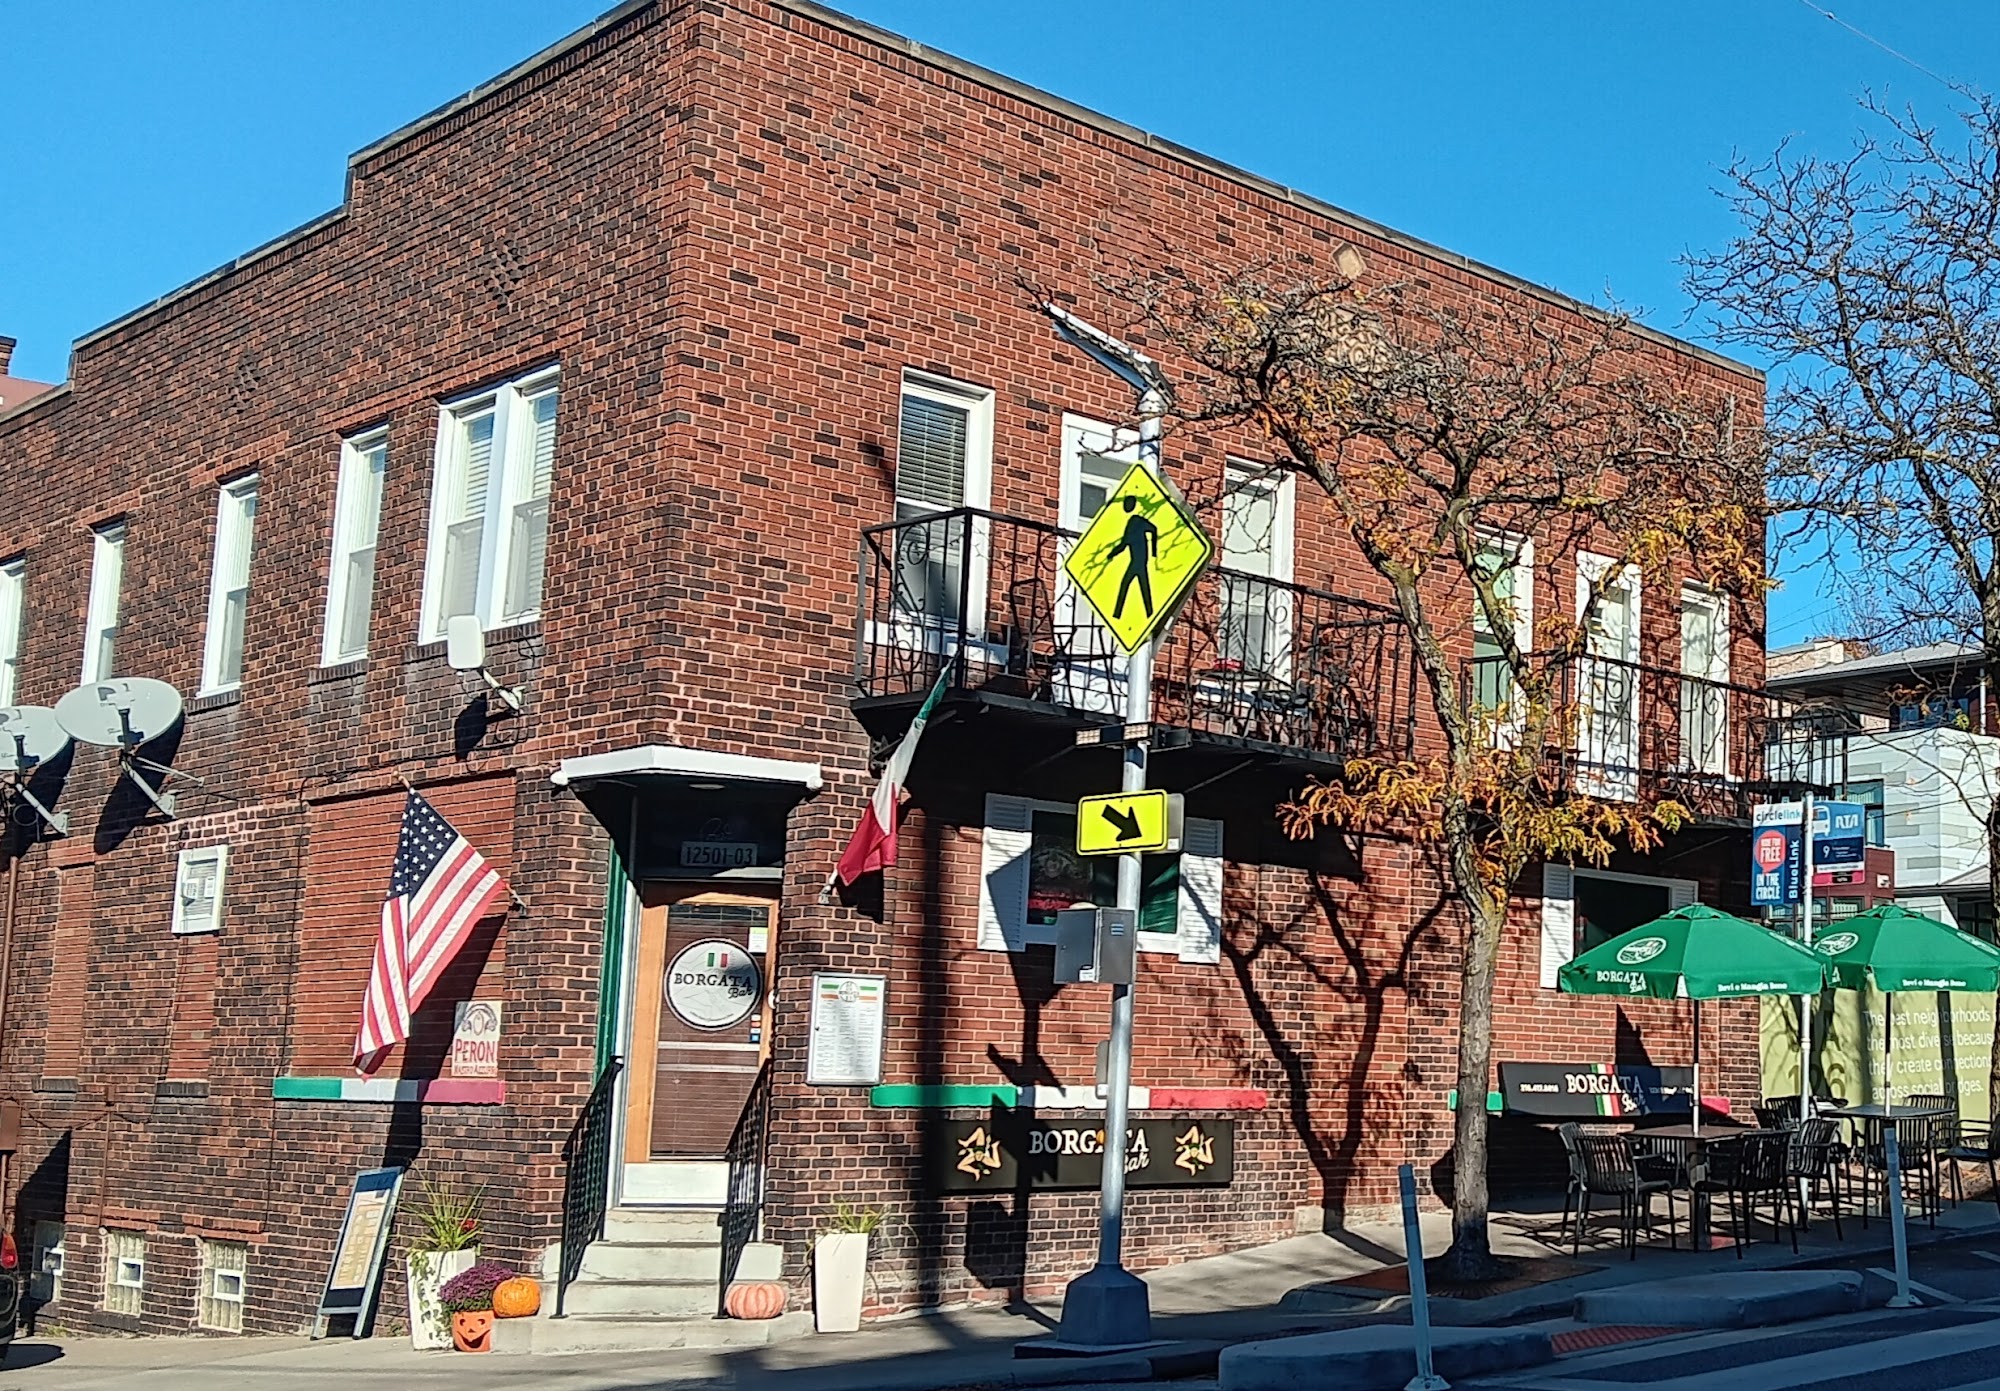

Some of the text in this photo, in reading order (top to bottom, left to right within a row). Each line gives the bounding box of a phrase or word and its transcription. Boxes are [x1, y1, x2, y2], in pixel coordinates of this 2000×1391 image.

[1756, 808, 1801, 823] circlelink
[1835, 814, 1859, 829] RTA
[686, 846, 753, 865] 12501-03
[1760, 846, 1781, 863] FREE
[1822, 845, 1831, 858] 9
[1788, 840, 1799, 899] BlueLink
[1756, 873, 1781, 886] IN THE
[1755, 886, 1781, 900] CIRCLE
[674, 973, 753, 988] BORGATA
[1596, 970, 1646, 984] BORGATA
[728, 987, 754, 999] Bar
[1863, 1010, 1885, 1026] The
[1914, 1006, 1991, 1027] neighborhoods
[1867, 1035, 1885, 1051] the
[1919, 1031, 1955, 1048] divese
[1957, 1030, 1994, 1046] becaus
[1896, 1059, 1932, 1074] create
[1934, 1052, 1992, 1070] cnnections
[1565, 1073, 1644, 1094] BORGATA
[1872, 1077, 1984, 1100] acoss social brdges.
